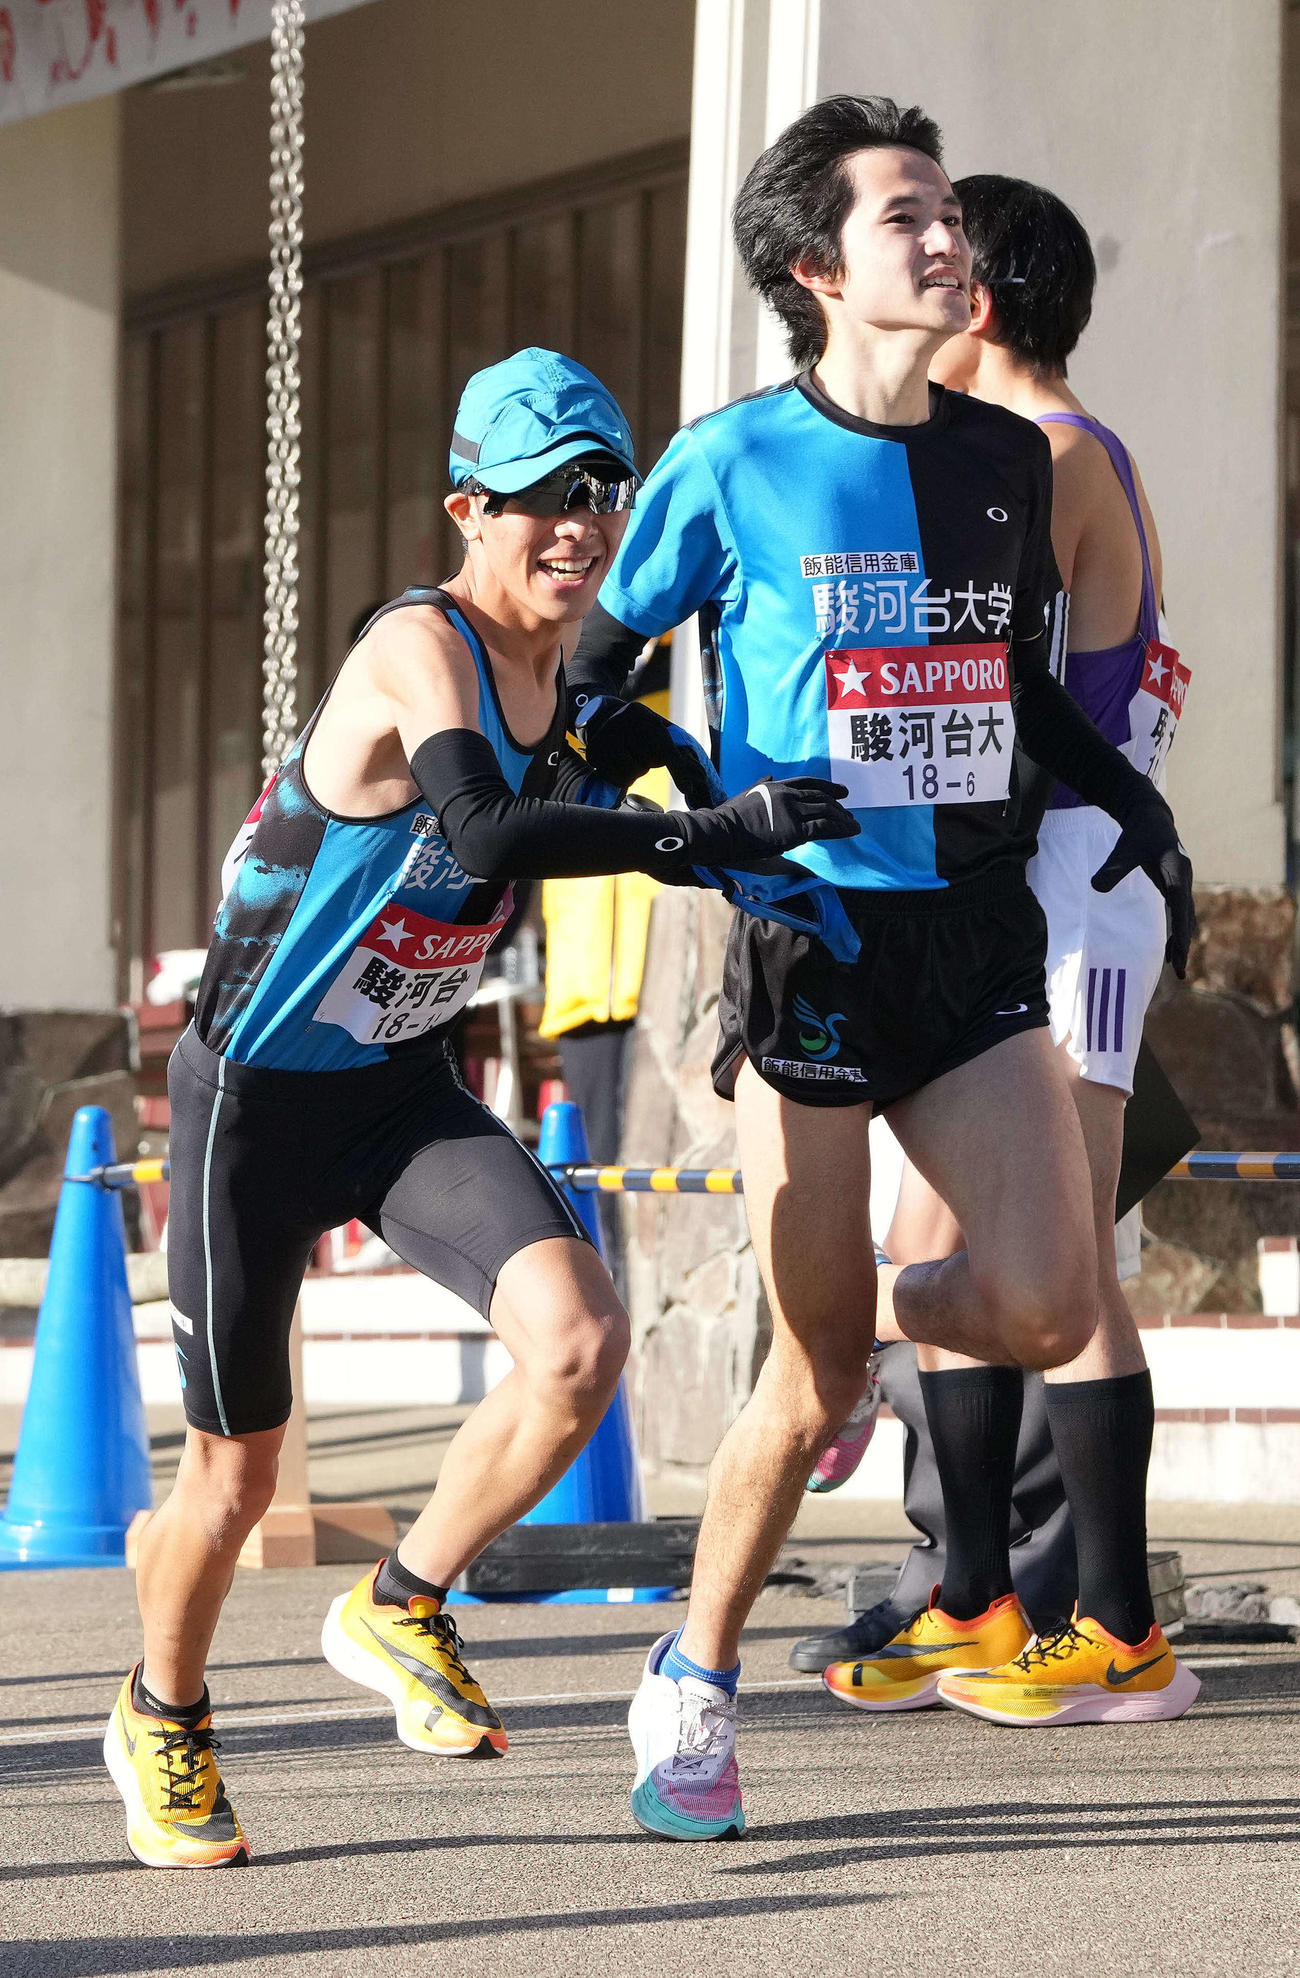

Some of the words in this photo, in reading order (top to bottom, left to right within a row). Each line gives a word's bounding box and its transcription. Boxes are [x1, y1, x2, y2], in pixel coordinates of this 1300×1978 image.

[803, 552, 918, 577] 飯能信用金庫
[811, 578, 1013, 636] 駿河台大学
[879, 657, 1005, 695] SAPPORO
[849, 706, 1004, 762] 駿河台大
[902, 764, 976, 801] 18-6
[411, 814, 441, 837] 飯
